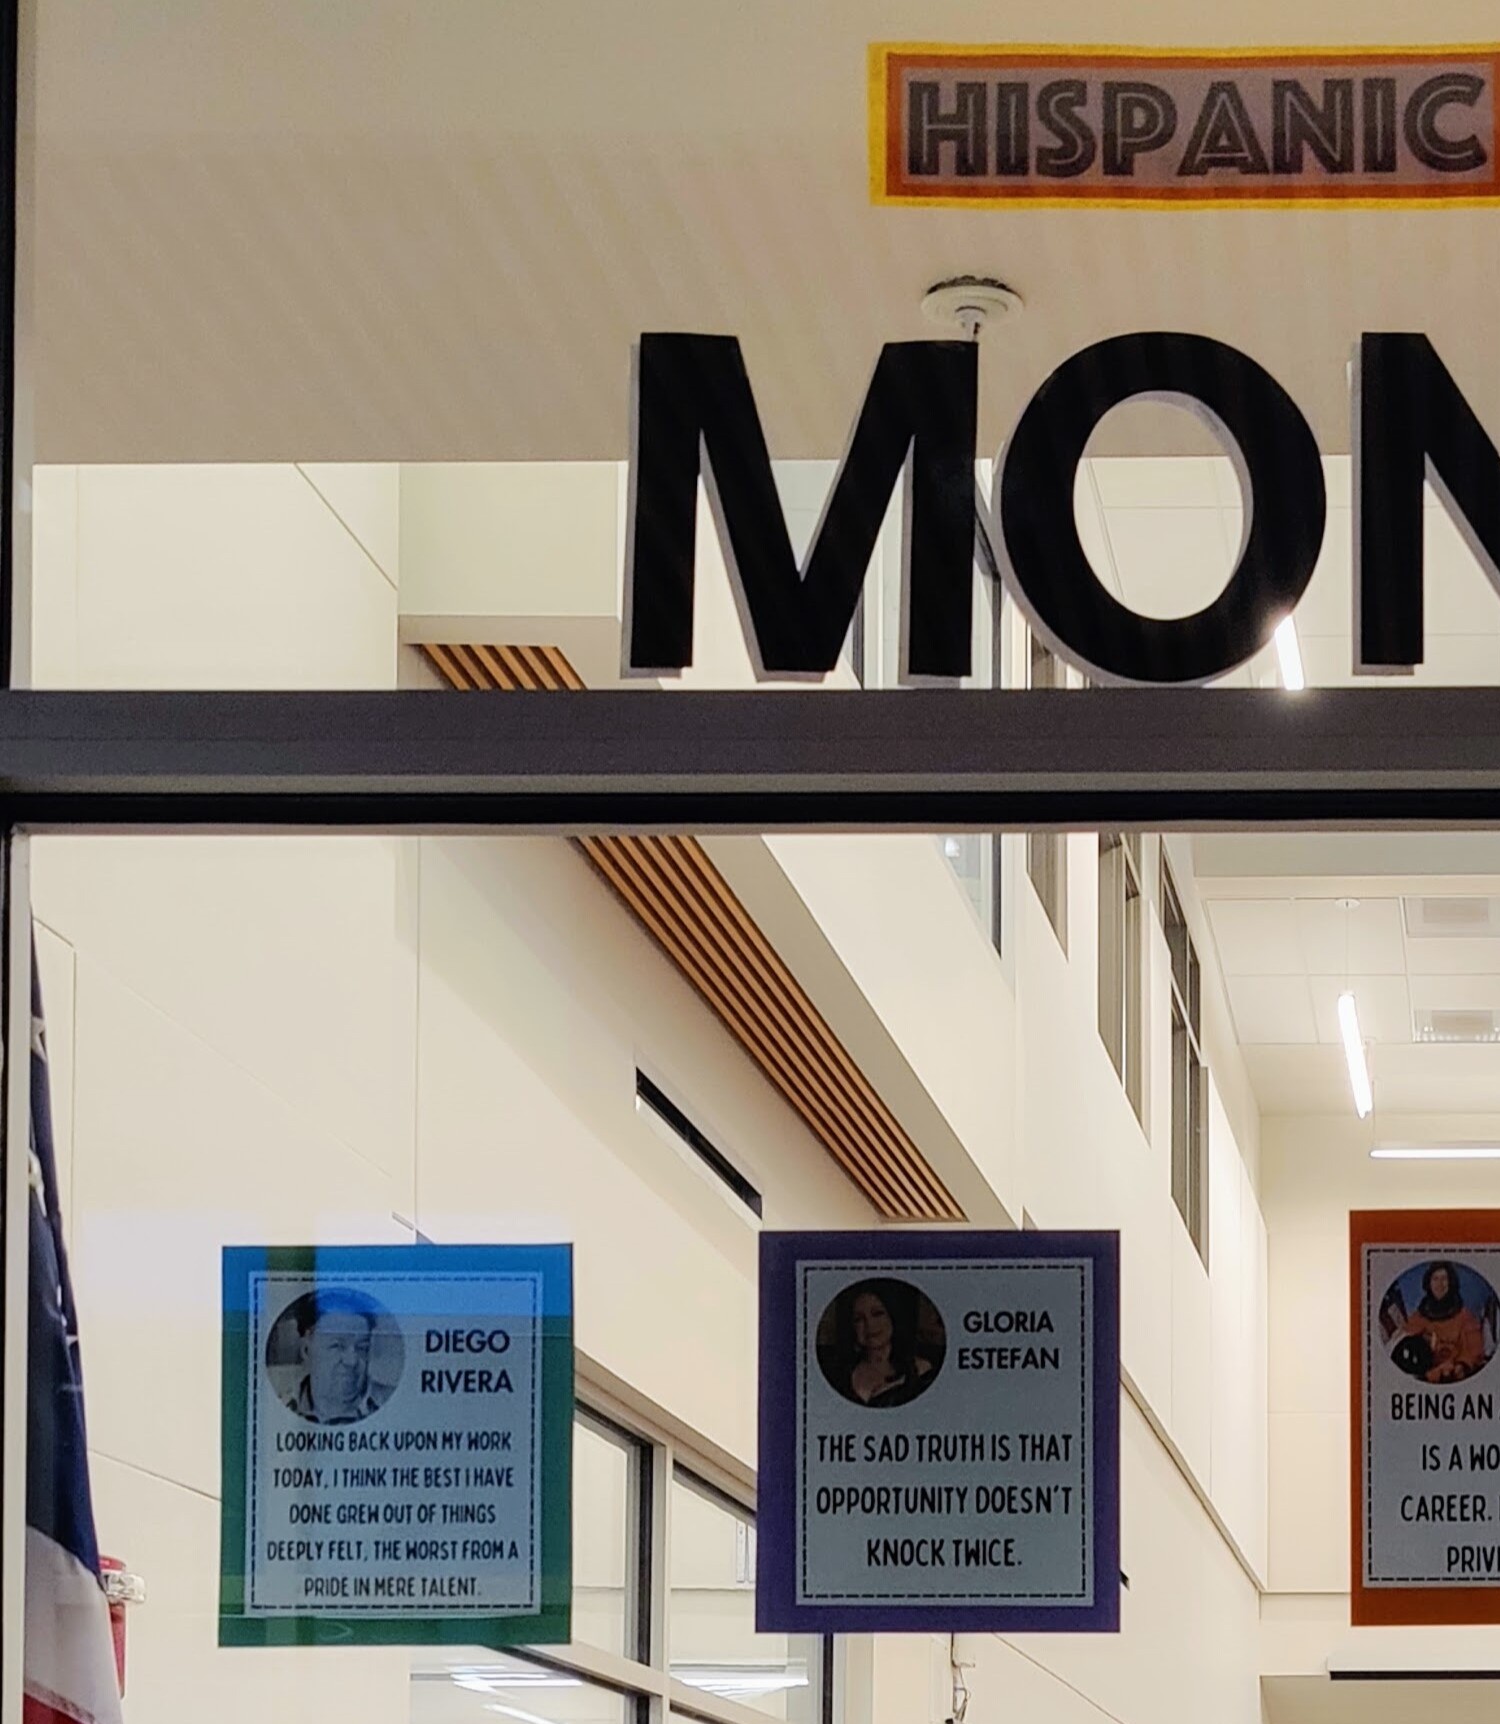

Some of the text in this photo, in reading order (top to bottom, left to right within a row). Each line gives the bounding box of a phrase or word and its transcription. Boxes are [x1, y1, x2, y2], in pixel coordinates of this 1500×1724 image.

[906, 70, 1486, 181] HISPANIC
[963, 1311, 1054, 1333] GLORIA
[426, 1329, 510, 1353] DIEGO
[958, 1347, 1059, 1370] ESTEFAN
[421, 1369, 514, 1394] RIVERA
[1391, 1393, 1455, 1420] BEING
[1461, 1393, 1493, 1420] AN
[277, 1431, 511, 1452] LOOKING BACK UPON MY WORK
[817, 1434, 1072, 1463] THE SAD TRUTH IS THAT
[1422, 1444, 1441, 1471] IS
[1448, 1444, 1463, 1471] A
[274, 1467, 514, 1489] TODAY, I THINK THE BEST I HAVE
[816, 1485, 1072, 1515] OPPORTUNITY DOESN'T
[1401, 1494, 1492, 1522] CAREER.
[290, 1503, 496, 1525] DONE GREW OUT OF THINGS
[267, 1540, 518, 1561] DEEPLY FELT, THE WORST FROM A
[867, 1538, 1022, 1567] KNOCK TWICE.
[304, 1576, 480, 1597] PRIDE IN MERE TALENT.
